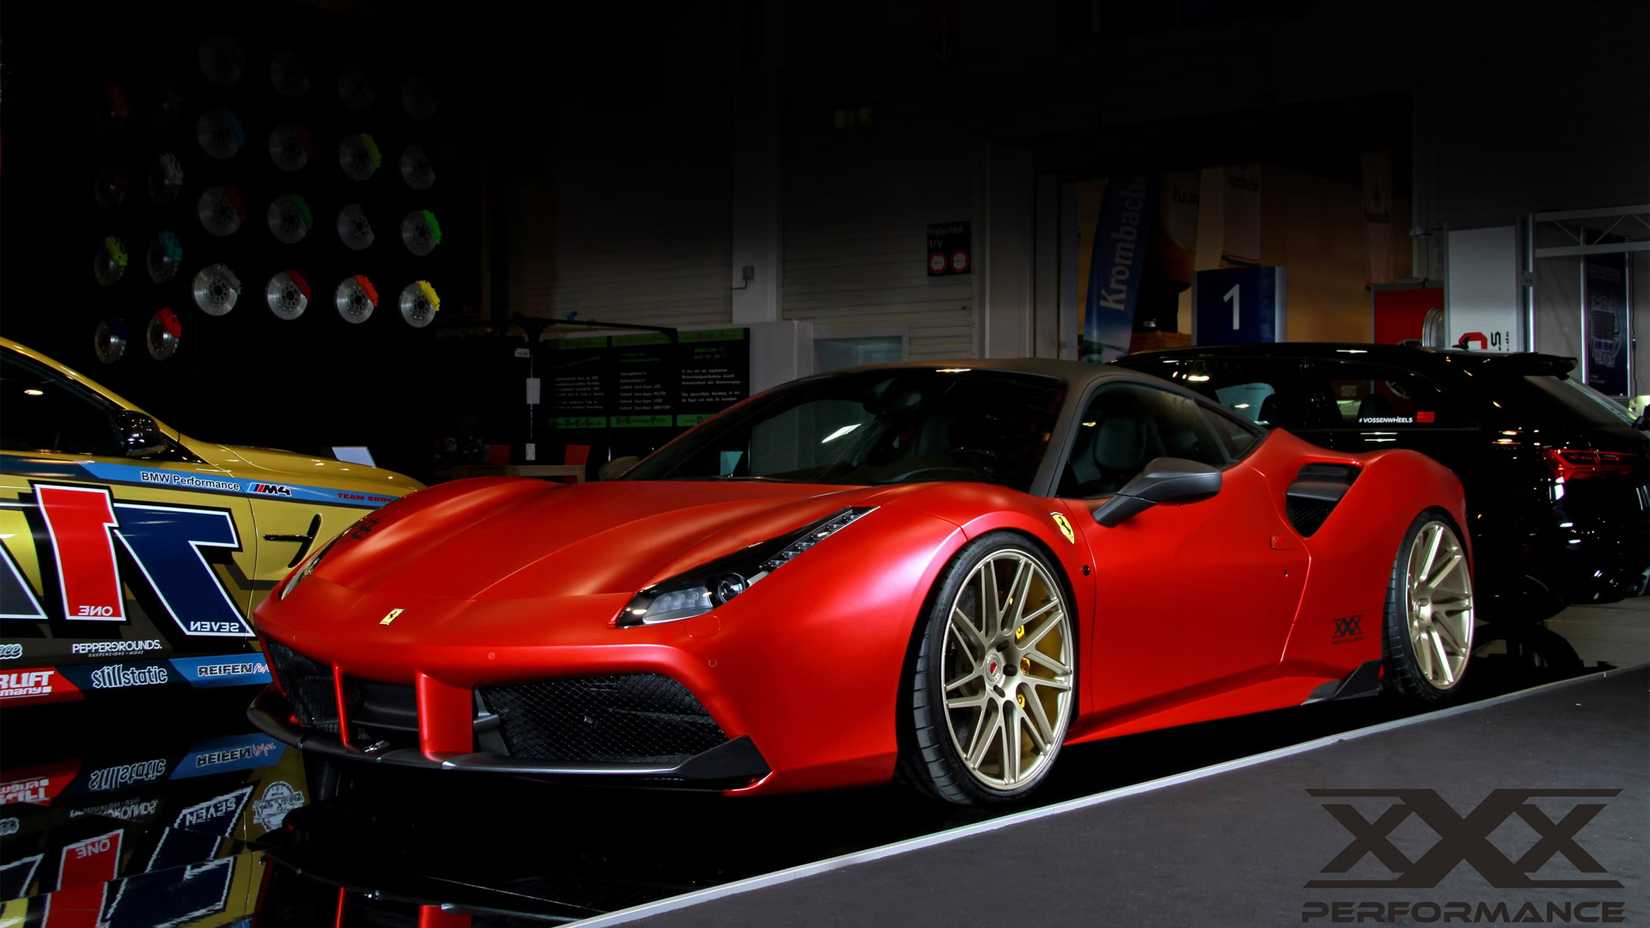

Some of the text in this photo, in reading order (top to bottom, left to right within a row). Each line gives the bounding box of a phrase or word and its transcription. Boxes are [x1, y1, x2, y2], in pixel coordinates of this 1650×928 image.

[1222, 284, 1240, 331] 1
[141, 471, 240, 491] BMW Performance
